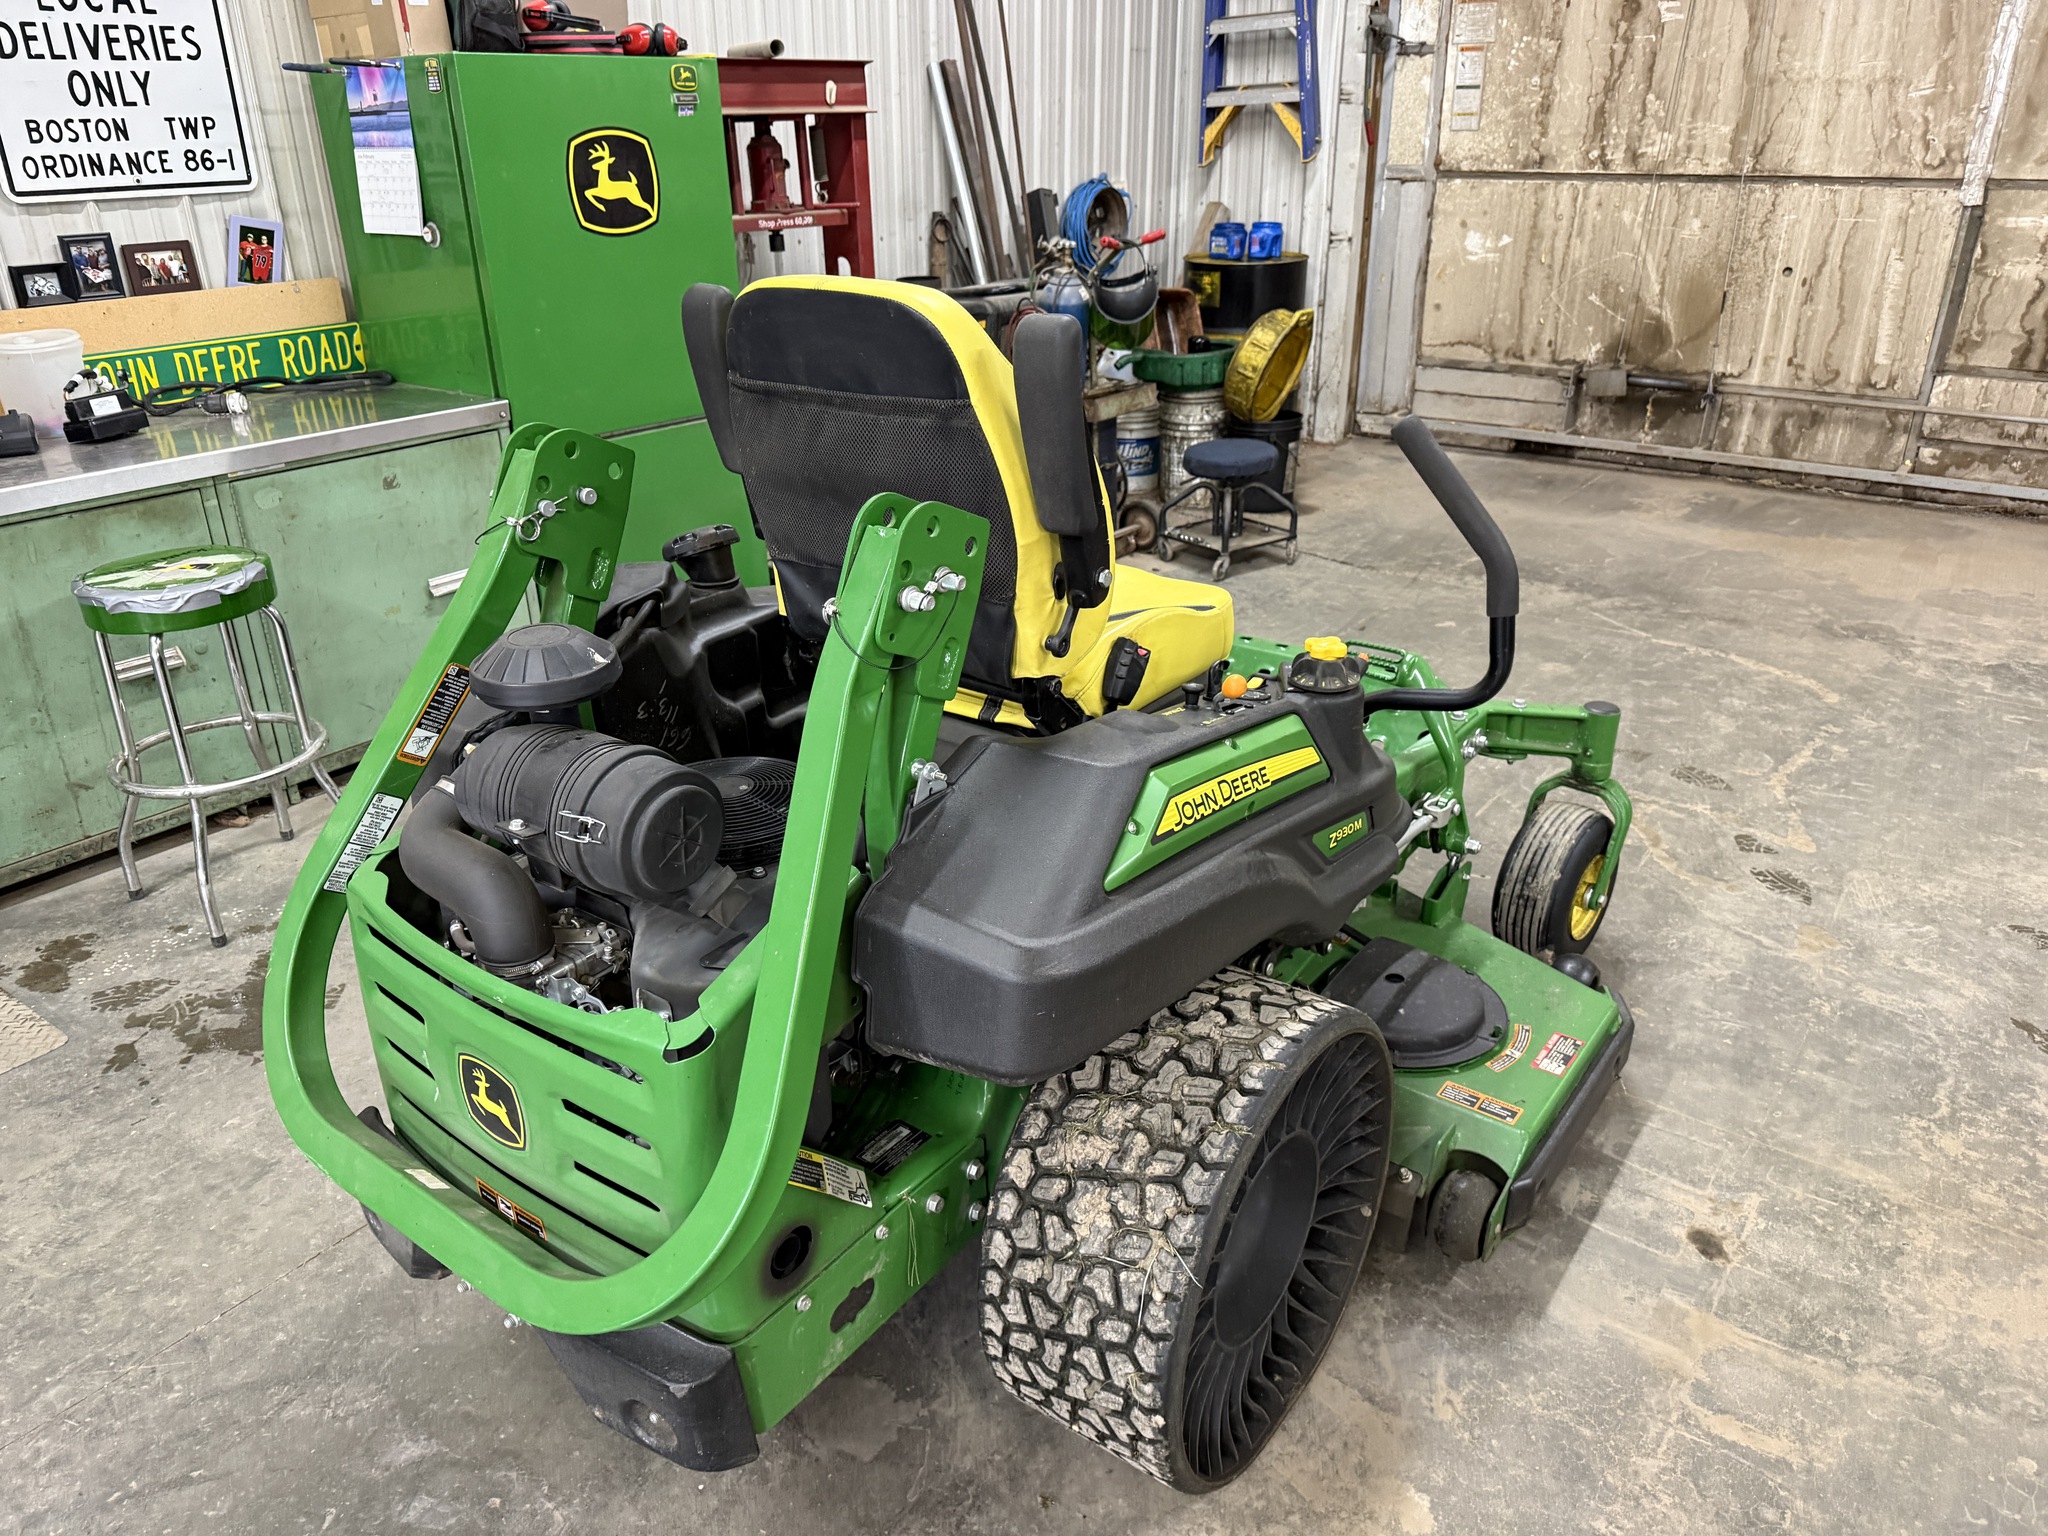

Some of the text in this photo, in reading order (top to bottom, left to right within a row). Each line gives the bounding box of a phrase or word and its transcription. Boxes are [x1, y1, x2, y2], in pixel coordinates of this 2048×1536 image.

[0, 21, 202, 61] DELIVERIES
[67, 70, 151, 107] ONLY
[24, 116, 216, 144] BOSTON TWP
[21, 149, 236, 180] ORDINANCE 86-1
[758, 219, 775, 228] Shop
[255, 254, 267, 268] 79
[173, 342, 261, 395] DEERE
[278, 331, 352, 379] ROAD
[1174, 766, 1271, 828] JOHN DEERE
[1328, 818, 1363, 849] Z930M
